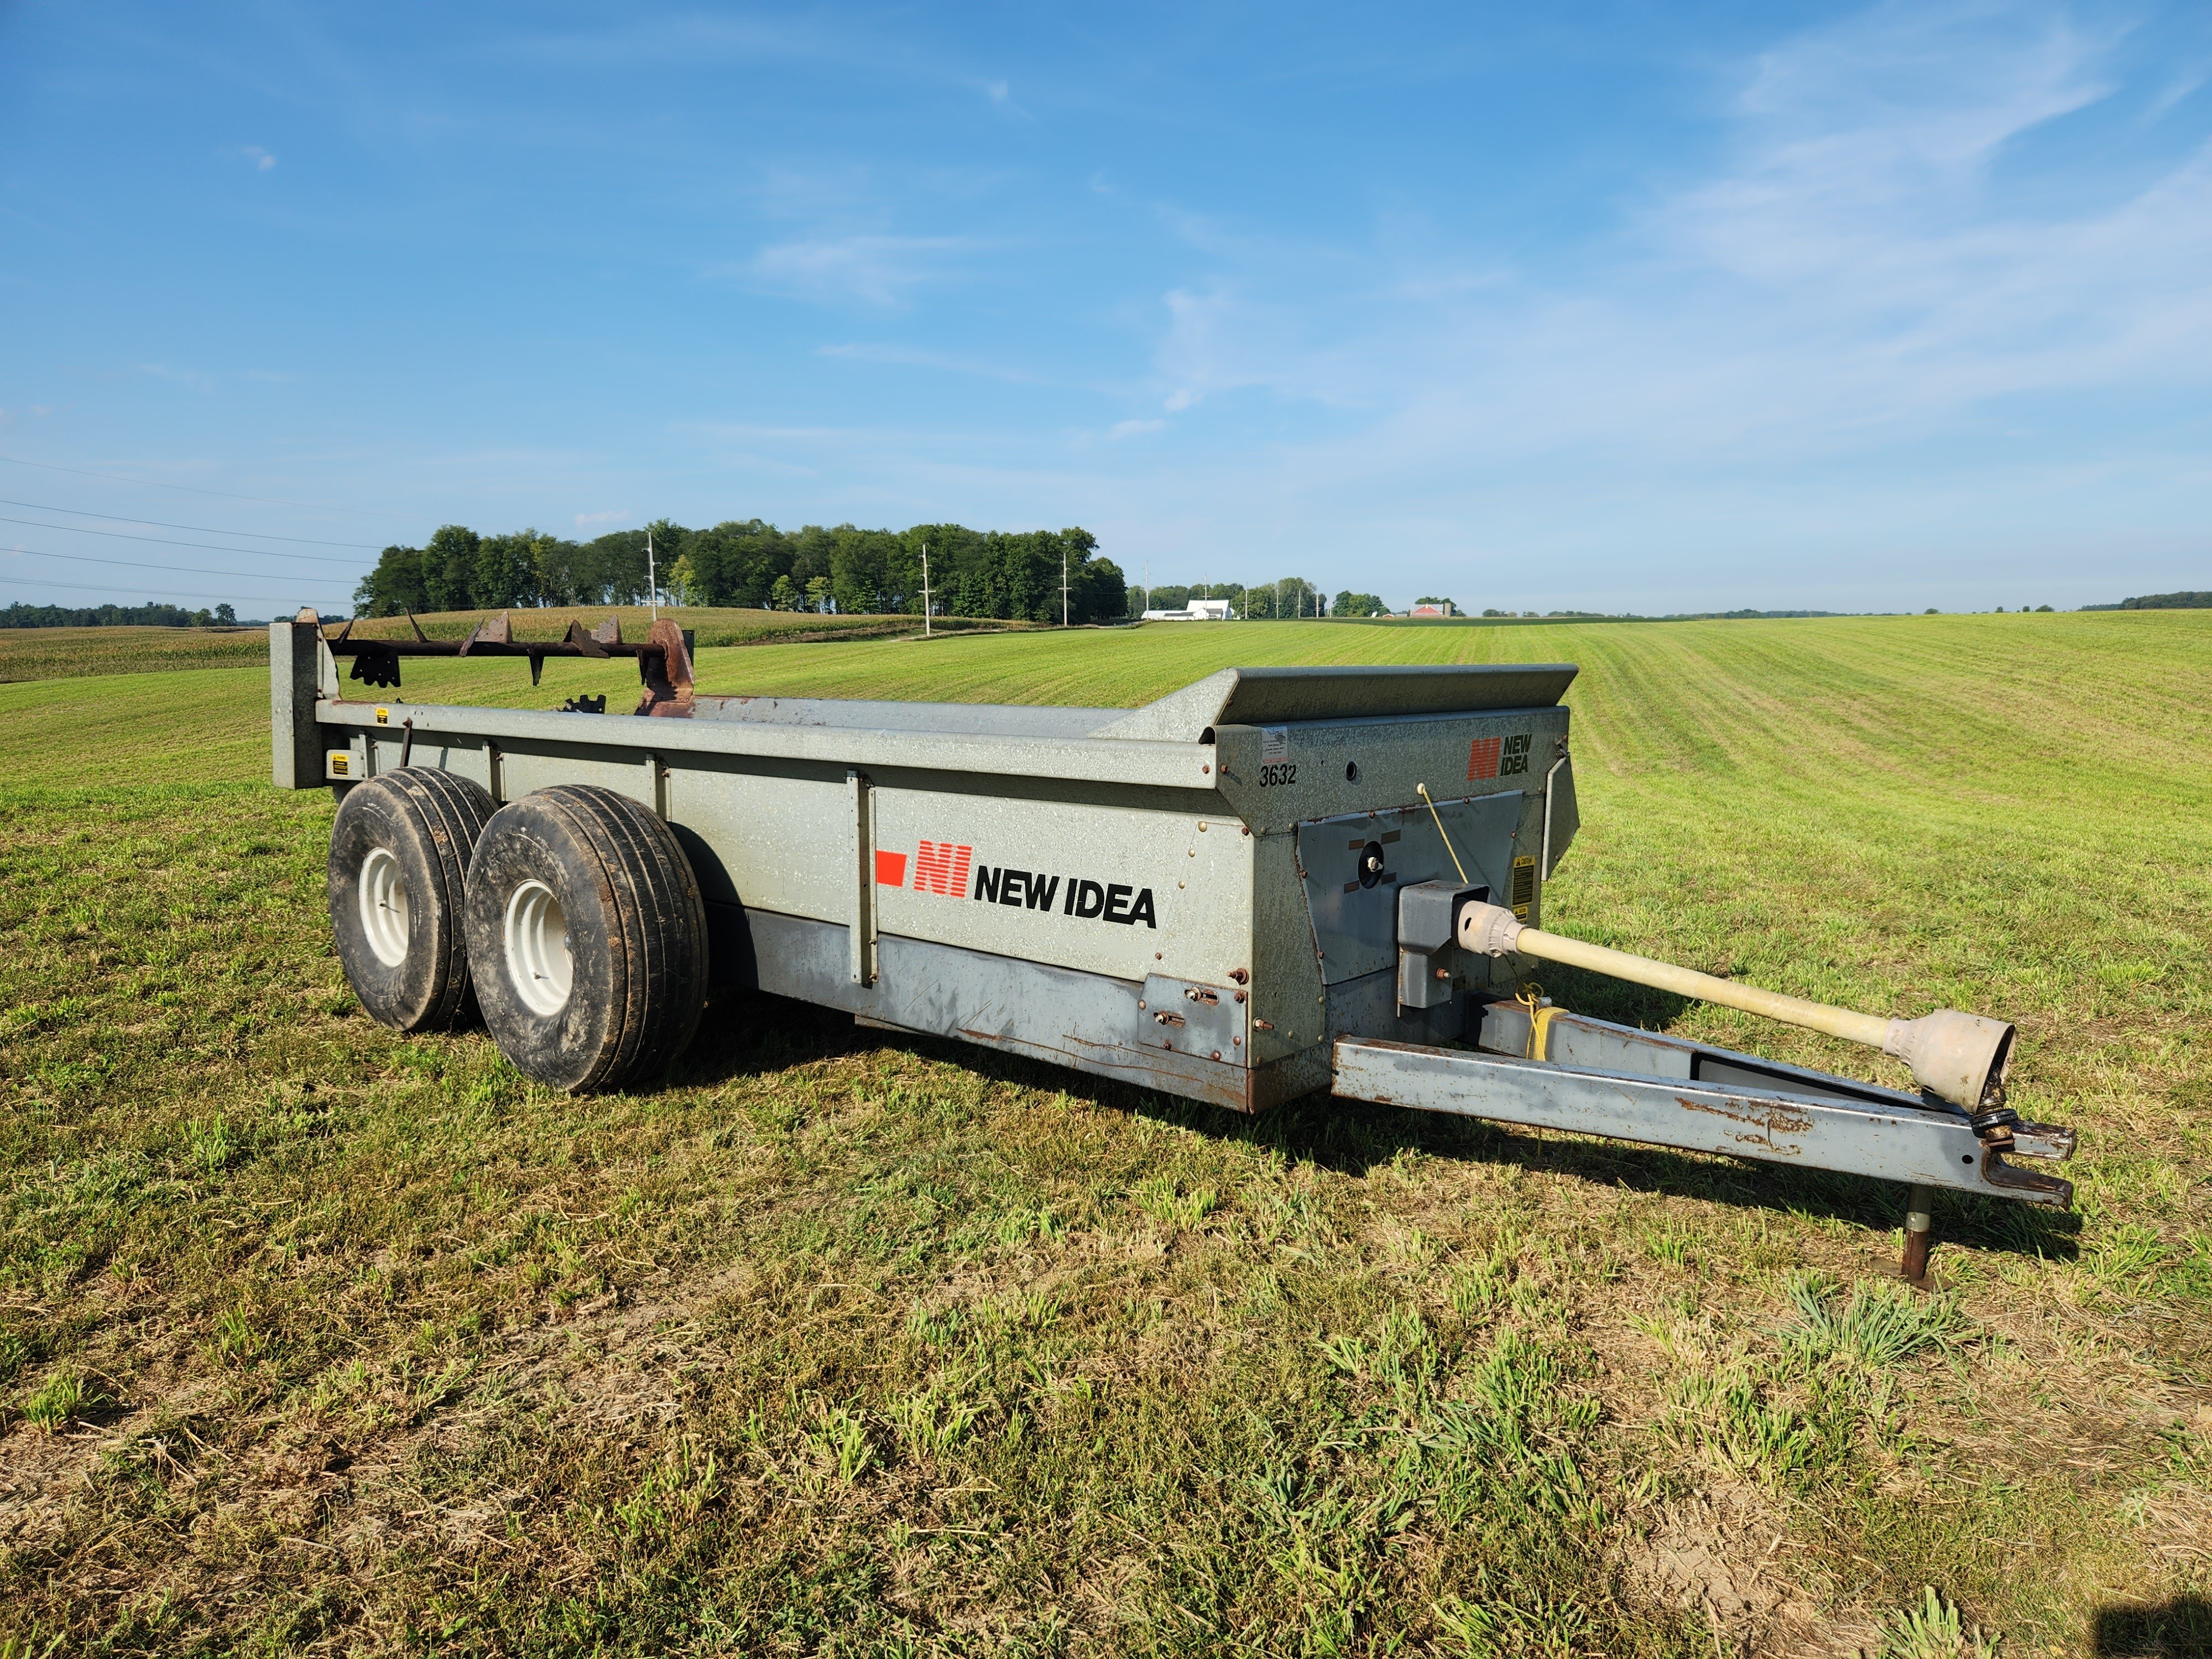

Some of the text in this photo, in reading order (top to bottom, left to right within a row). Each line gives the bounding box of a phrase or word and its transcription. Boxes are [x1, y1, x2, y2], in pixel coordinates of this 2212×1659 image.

[1503, 733, 1532, 755] NEW
[1259, 764, 1297, 787] 3632
[1500, 754, 1528, 776] IDEA
[974, 865, 1157, 929] NEW IDEA
